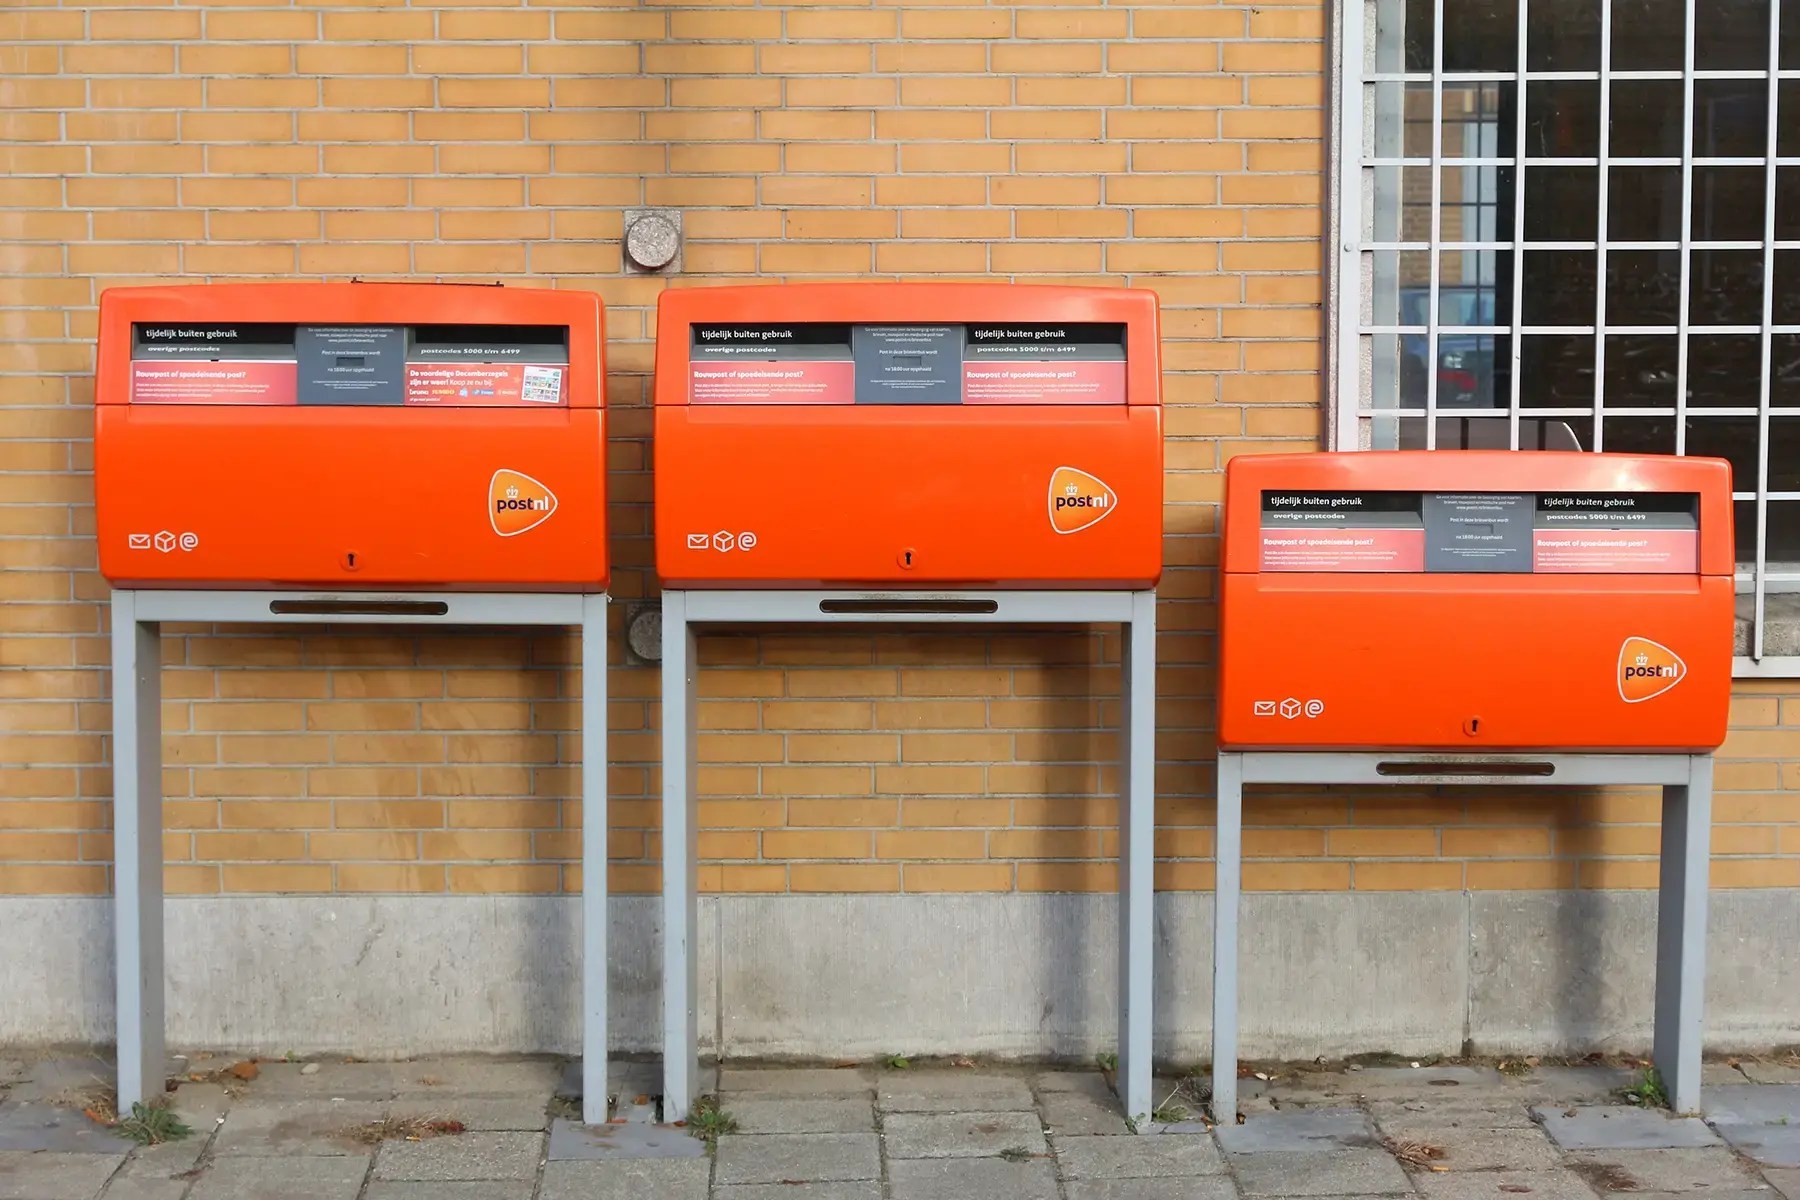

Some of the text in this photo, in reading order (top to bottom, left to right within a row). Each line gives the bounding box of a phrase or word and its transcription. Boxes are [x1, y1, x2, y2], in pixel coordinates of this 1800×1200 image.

[146, 330, 237, 339] tijdelijk buiten gebruik
[702, 331, 732, 340] tijdelijk
[762, 331, 793, 340] gebruik
[975, 330, 1065, 339] tijdelijk buiten gebruik
[179, 371, 226, 379] spoedeisende
[227, 371, 246, 379] post?
[420, 370, 454, 378] voordelige
[456, 370, 508, 378] Decemberzegels
[694, 371, 727, 379] Rouwpost
[737, 371, 784, 379] spoedeisende
[785, 371, 803, 379] post?
[967, 371, 1000, 379] Rouwpost
[410, 379, 421, 387] zijn
[450, 379, 465, 387] Koop
[497, 496, 549, 514] postnl
[1056, 493, 1108, 511] postnl
[1271, 497, 1362, 507] tijdelijk buiten gebruik
[1544, 498, 1574, 507] tijdelijk
[1604, 499, 1635, 507] gebruik
[1264, 538, 1297, 546] Rouwpost
[1626, 663, 1677, 680] postnl
